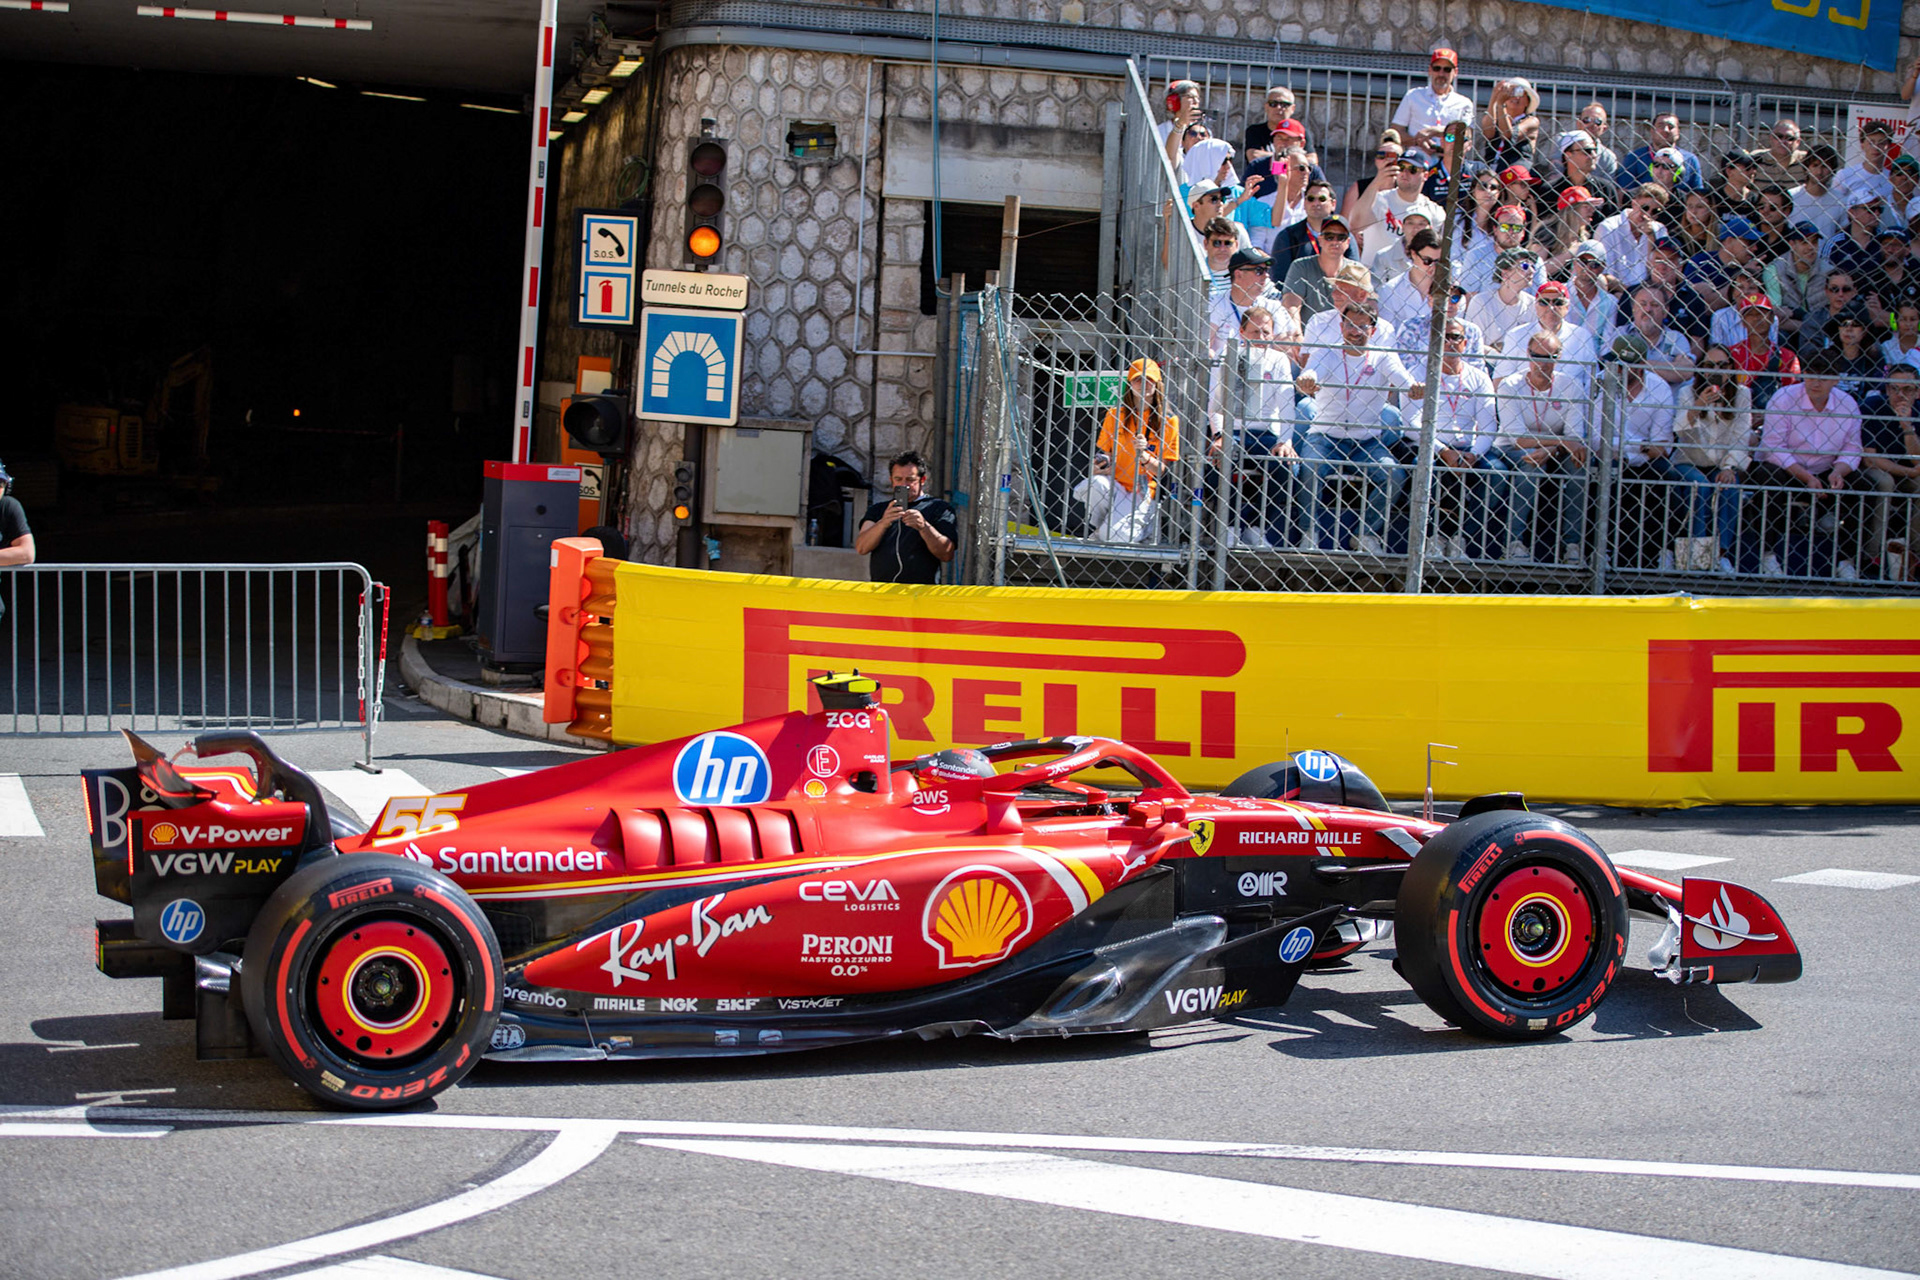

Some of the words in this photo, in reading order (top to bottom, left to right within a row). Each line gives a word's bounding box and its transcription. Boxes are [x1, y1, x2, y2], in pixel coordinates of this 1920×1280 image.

[646, 280, 686, 294] Tunnels
[690, 283, 702, 295] du
[705, 284, 743, 298] Rocher
[743, 607, 1246, 759] PRELLI
[689, 734, 759, 805] hp
[939, 761, 978, 774] Santander
[1305, 752, 1329, 781] hp
[913, 789, 948, 805] aws
[372, 793, 468, 848] 55
[180, 825, 292, 844] V-Power
[1239, 832, 1310, 845] RICHARD
[1315, 832, 1362, 845] MILLE
[440, 846, 607, 874] Santander
[1457, 842, 1504, 894] PIRELLI
[328, 877, 394, 910] PIRELLI
[844, 902, 900, 911] LOGISTICS
[166, 900, 200, 943] hp
[802, 934, 893, 955] PERONI
[1283, 927, 1311, 963] hp
[1615, 932, 1624, 956] P
[831, 965, 868, 977] 0.0%
[503, 984, 567, 1009] brembo
[594, 998, 645, 1012] MAHLE
[660, 998, 698, 1012] NGK
[716, 998, 760, 1012] SKF
[1555, 960, 1617, 1027] ZERO
[455, 1043, 471, 1068] P
[350, 1065, 448, 1100] ZERO
